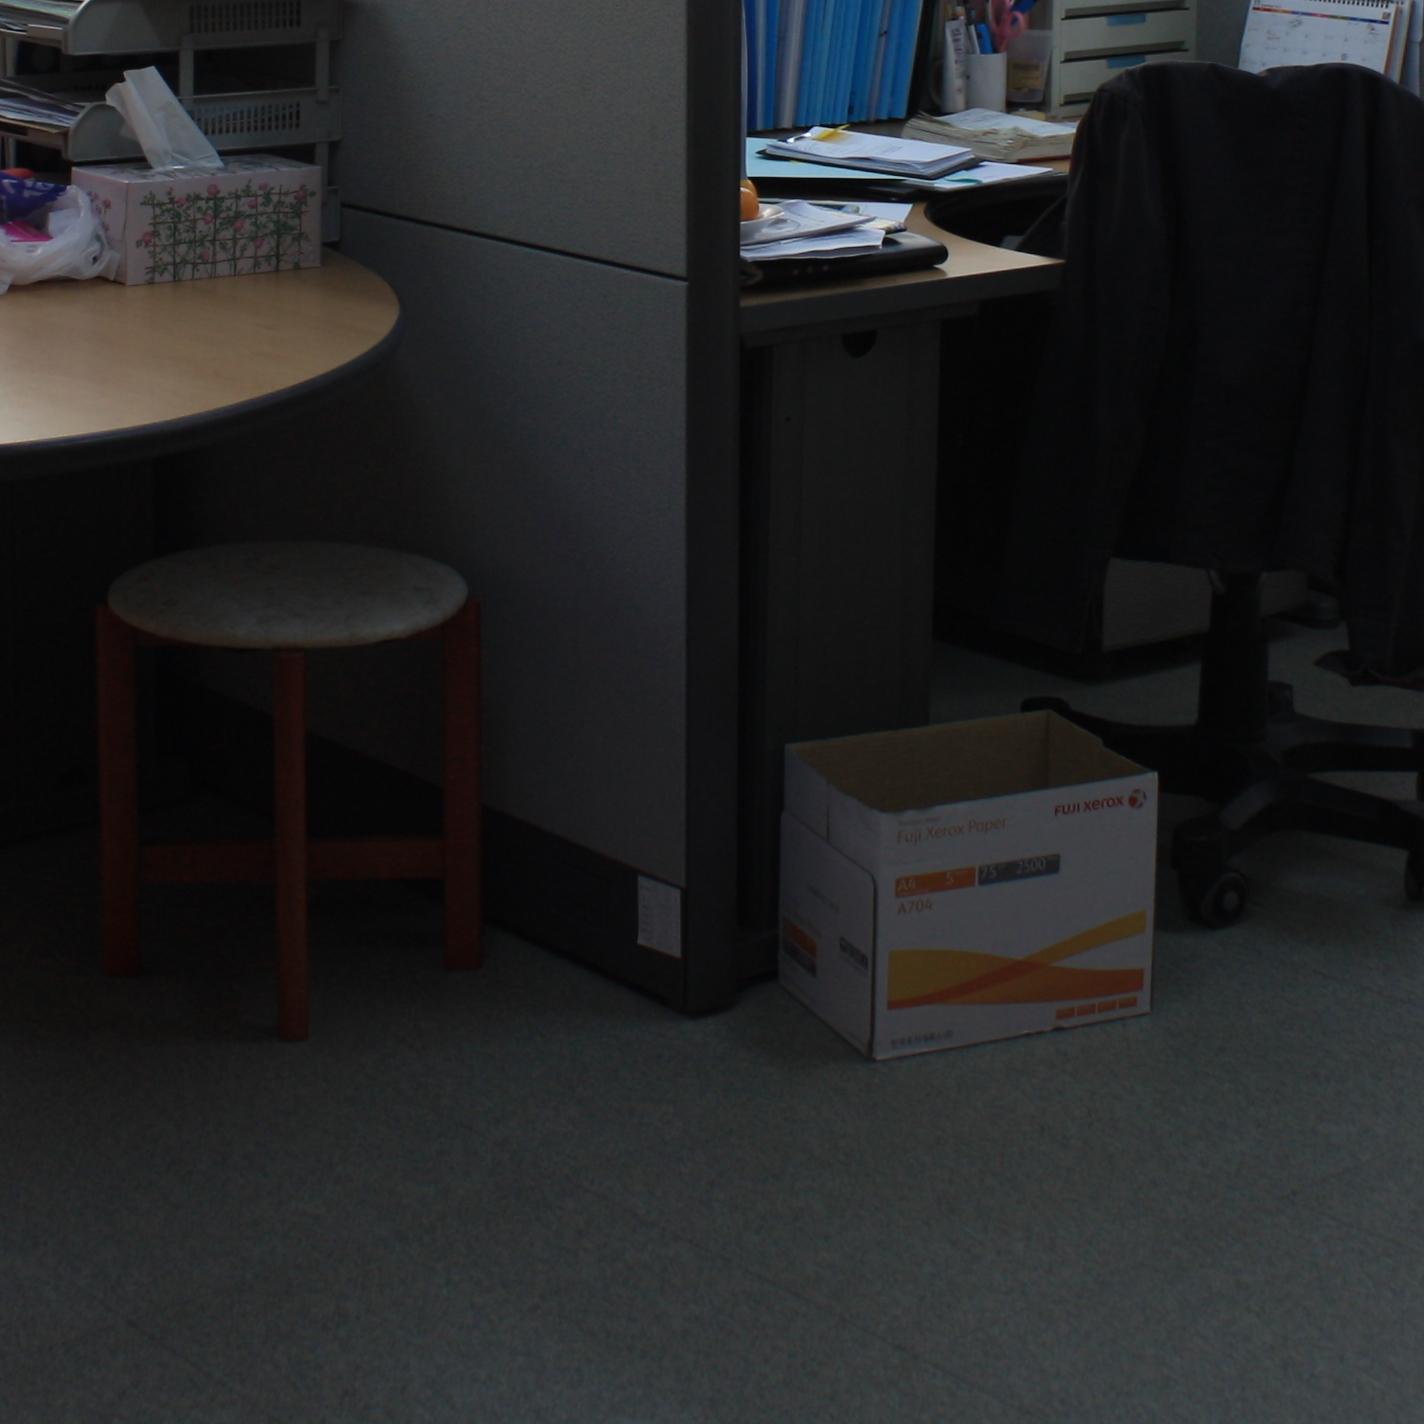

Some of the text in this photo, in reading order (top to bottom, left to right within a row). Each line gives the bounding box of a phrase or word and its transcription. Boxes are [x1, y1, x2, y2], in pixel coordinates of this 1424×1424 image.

[1054, 795, 1124, 817] FUJI xerox
[896, 817, 1008, 845] Fuji Xerox Paper
[897, 877, 917, 891] A4
[896, 898, 934, 915] A704
